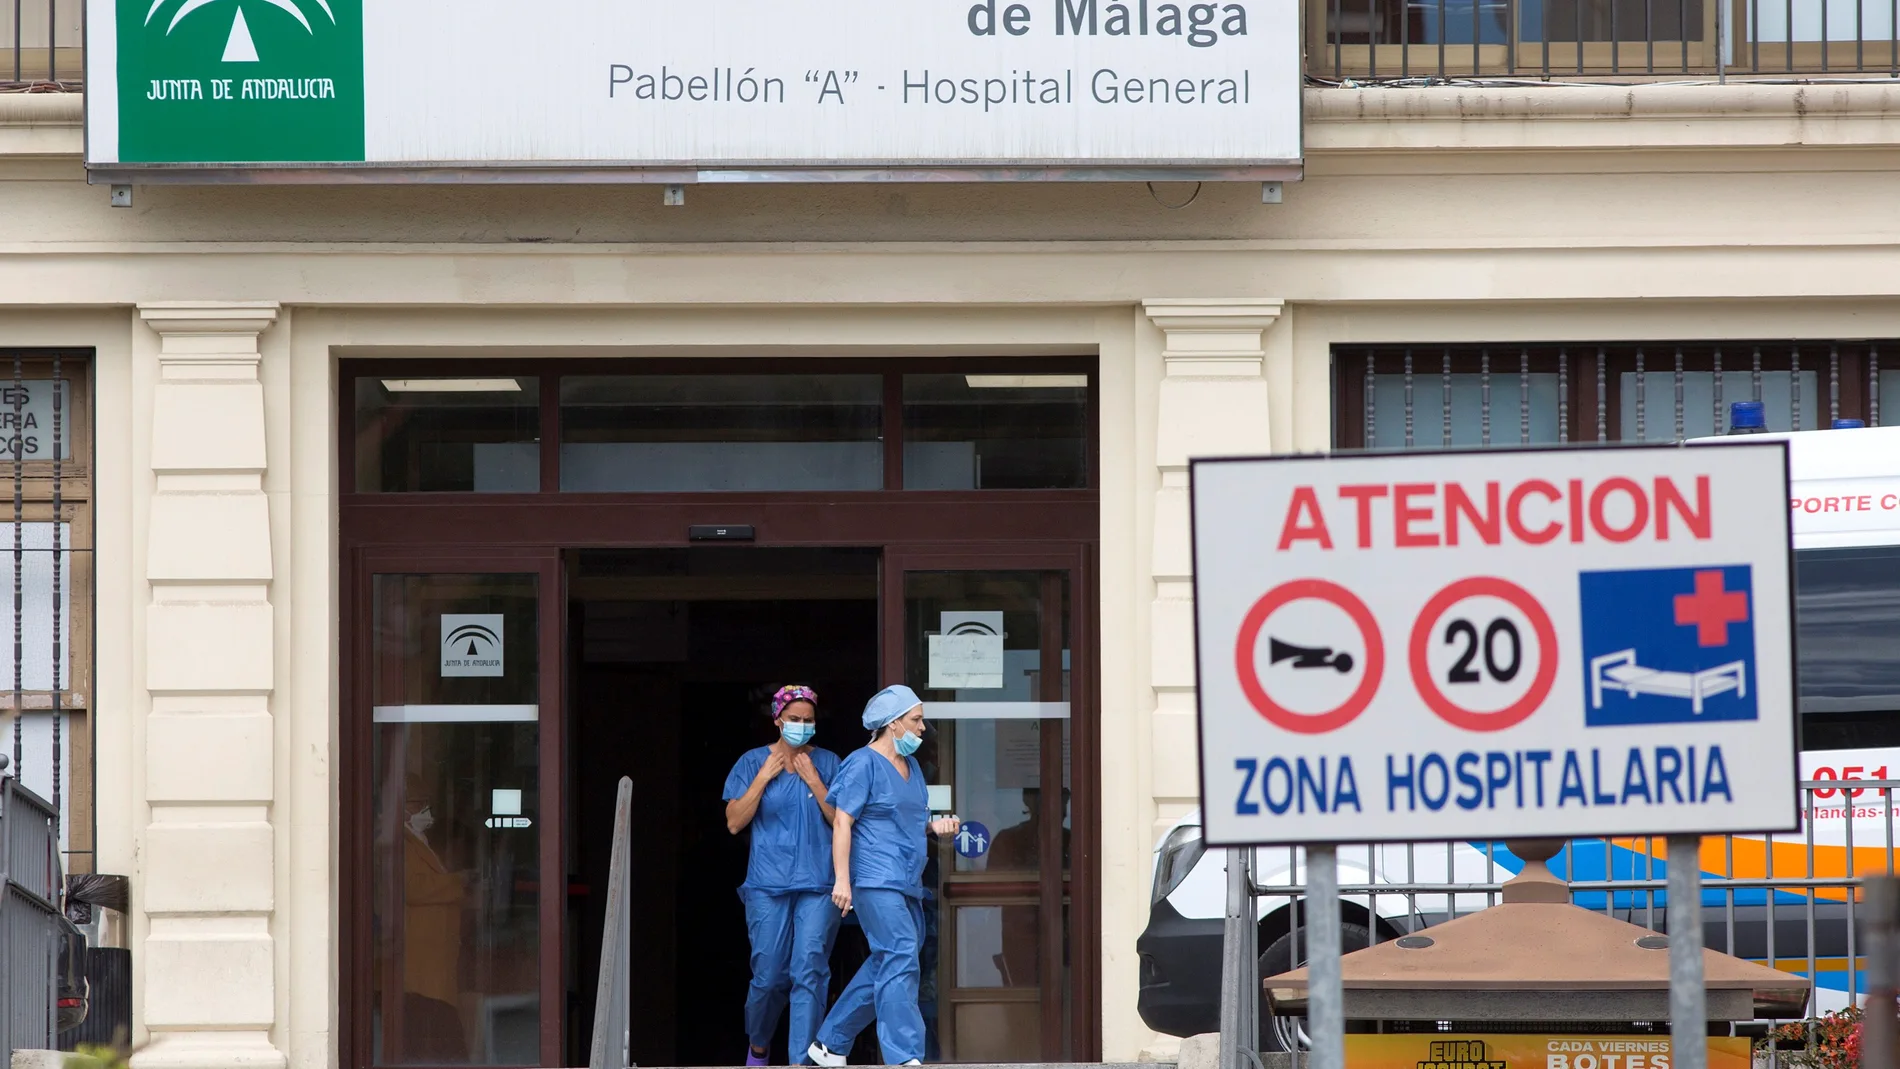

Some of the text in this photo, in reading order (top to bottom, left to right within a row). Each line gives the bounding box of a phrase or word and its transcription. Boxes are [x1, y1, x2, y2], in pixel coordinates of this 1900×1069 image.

[968, 0, 1248, 48] de Málaga
[147, 78, 335, 100] JUNTA DE ANDALUCIA
[609, 63, 784, 103] Pabellón
[903, 69, 1071, 112] Hospital
[1091, 68, 1249, 105] General
[0, 387, 30, 405] ES
[1276, 474, 1713, 552] ATENCION
[1444, 617, 1523, 684] 20
[1233, 744, 1734, 816] ZONA HOSPITALARIA
[1812, 765, 1888, 799] 051
[1430, 1041, 1485, 1062] EURO
[1546, 1053, 1670, 1069] BOTES
[1547, 1041, 1670, 1053] CADA VIERNES
